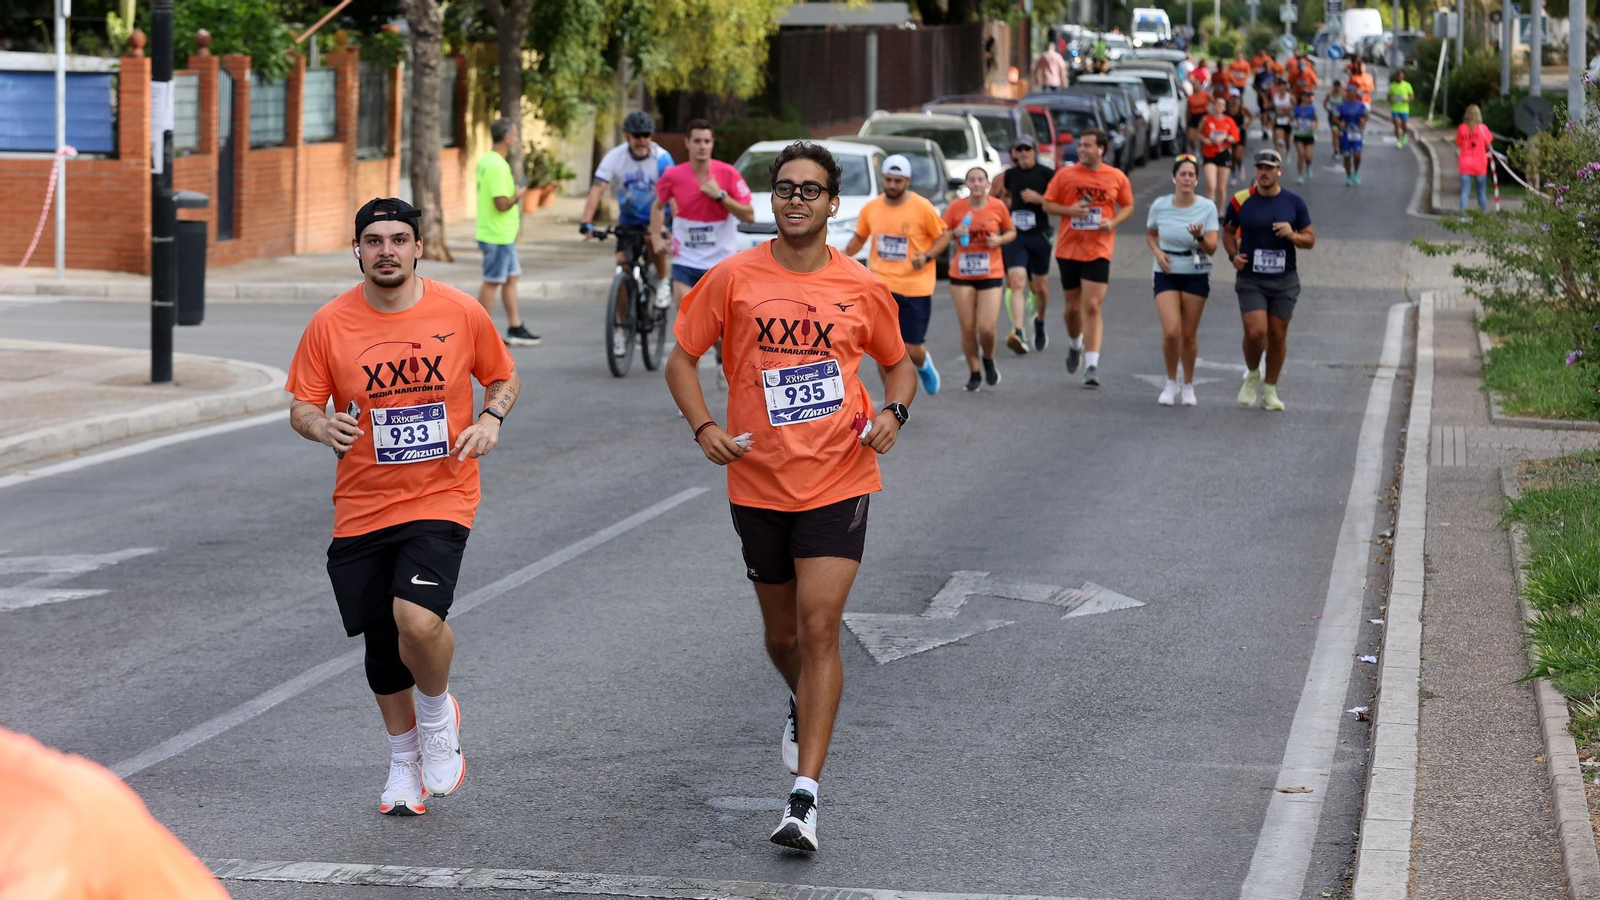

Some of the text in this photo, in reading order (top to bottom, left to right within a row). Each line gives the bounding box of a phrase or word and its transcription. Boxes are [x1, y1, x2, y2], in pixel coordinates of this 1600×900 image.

[755, 317, 835, 348] XXIX
[759, 345, 779, 353] MEDIA
[780, 348, 819, 356] MARATÓN
[362, 356, 445, 391] XXIX
[369, 391, 393, 399] MEDIA
[394, 385, 433, 395] MARATÓN
[785, 382, 825, 405] 935
[390, 424, 429, 446] 933
